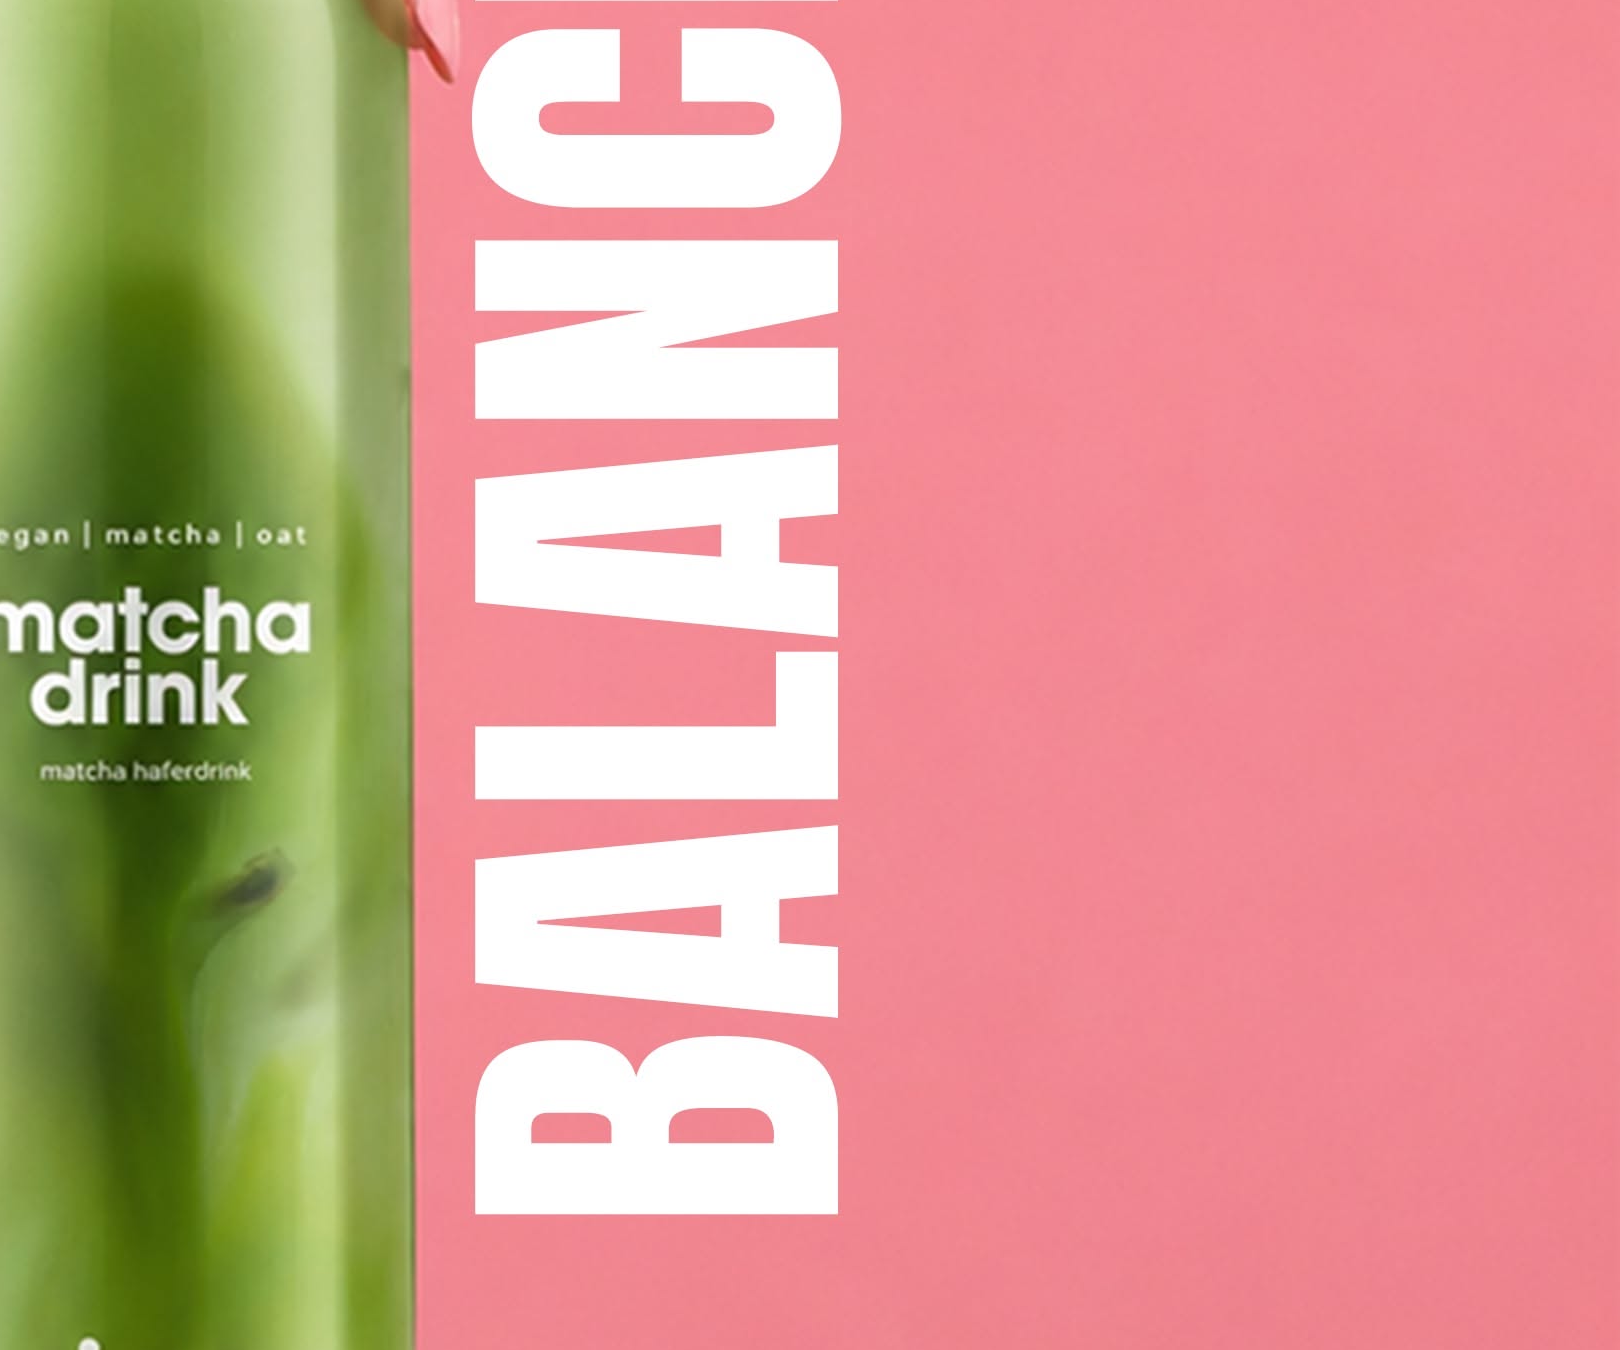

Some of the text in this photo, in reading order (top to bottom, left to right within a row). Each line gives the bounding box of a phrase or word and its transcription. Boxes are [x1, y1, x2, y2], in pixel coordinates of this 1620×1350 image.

[105, 523, 221, 545] matcha
[256, 525, 308, 545] oat
[30, 658, 249, 726] drink
[40, 760, 252, 782] matcha haferdrink
